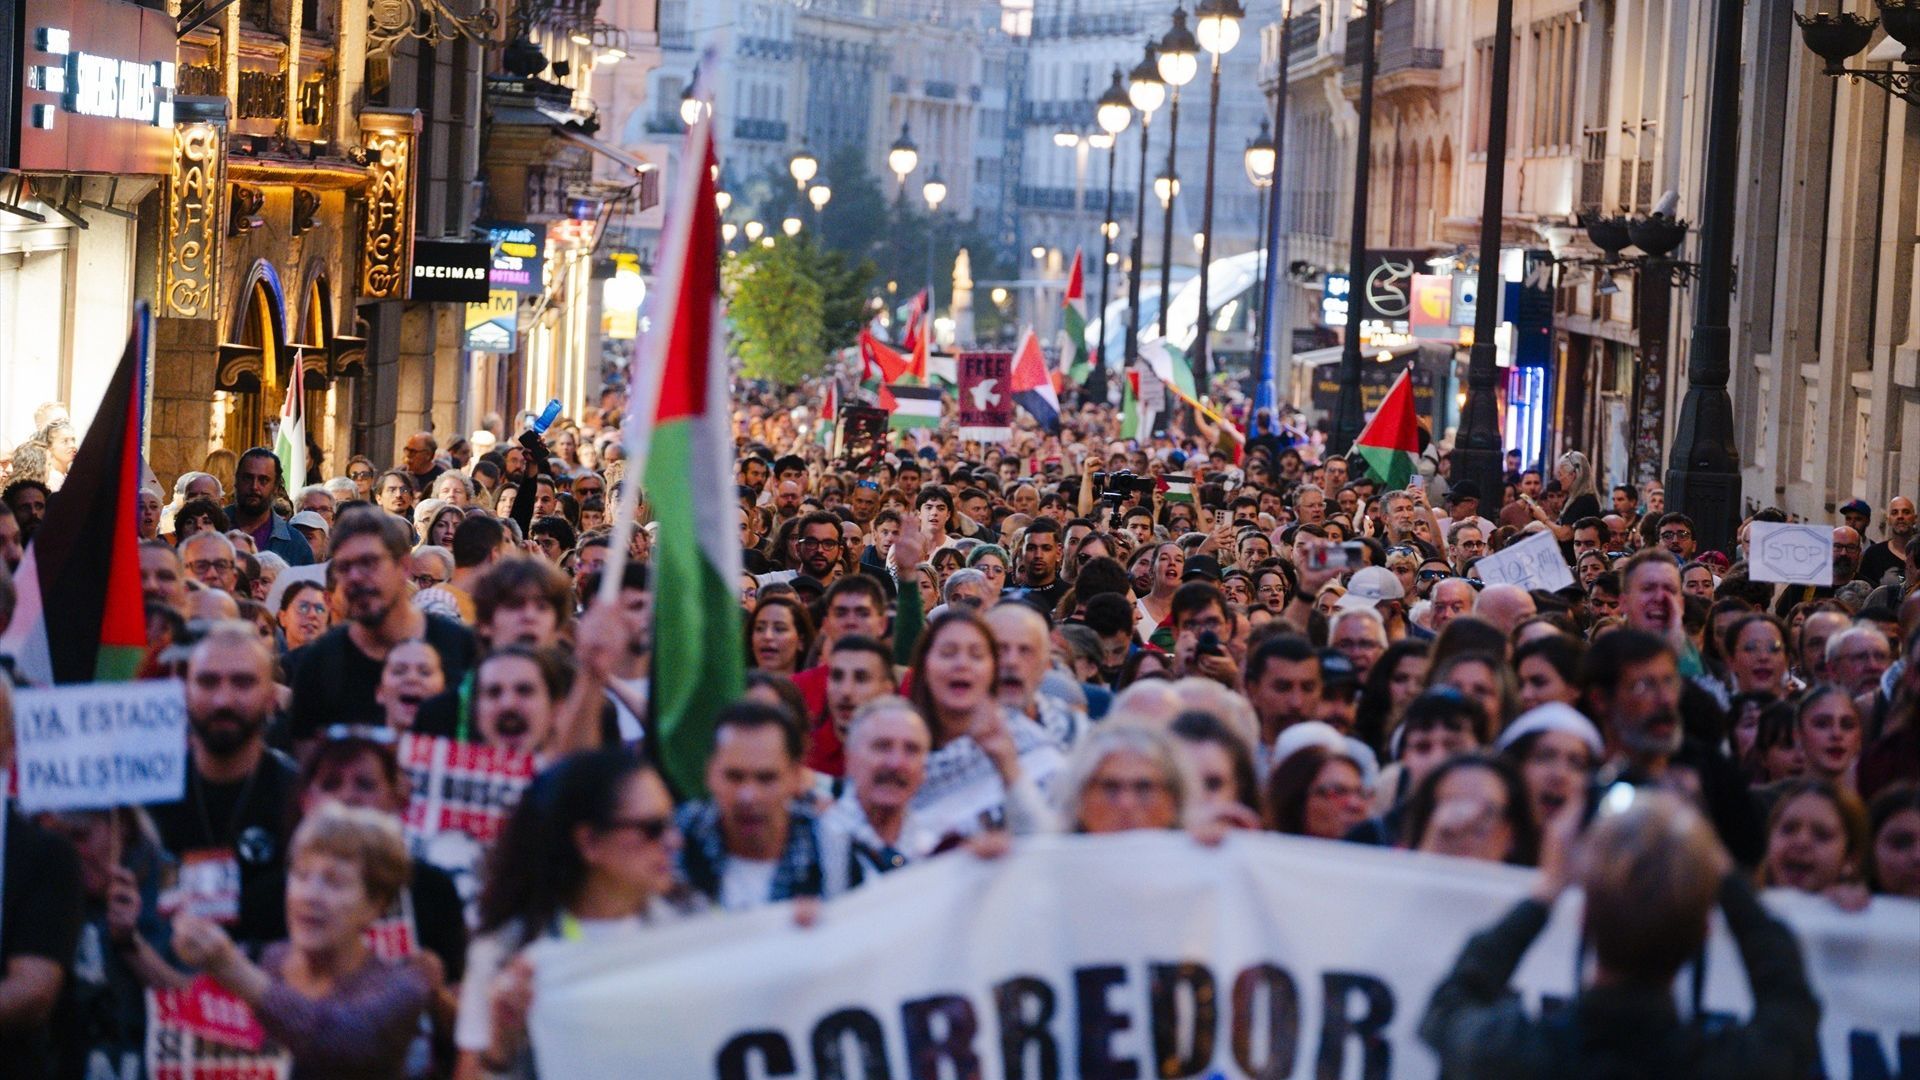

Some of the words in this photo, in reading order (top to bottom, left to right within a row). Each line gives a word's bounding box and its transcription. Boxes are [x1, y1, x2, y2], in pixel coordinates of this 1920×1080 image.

[414, 265, 486, 280] DECIMAS
[965, 357, 1006, 378] FREE
[1767, 541, 1823, 565] STOP
